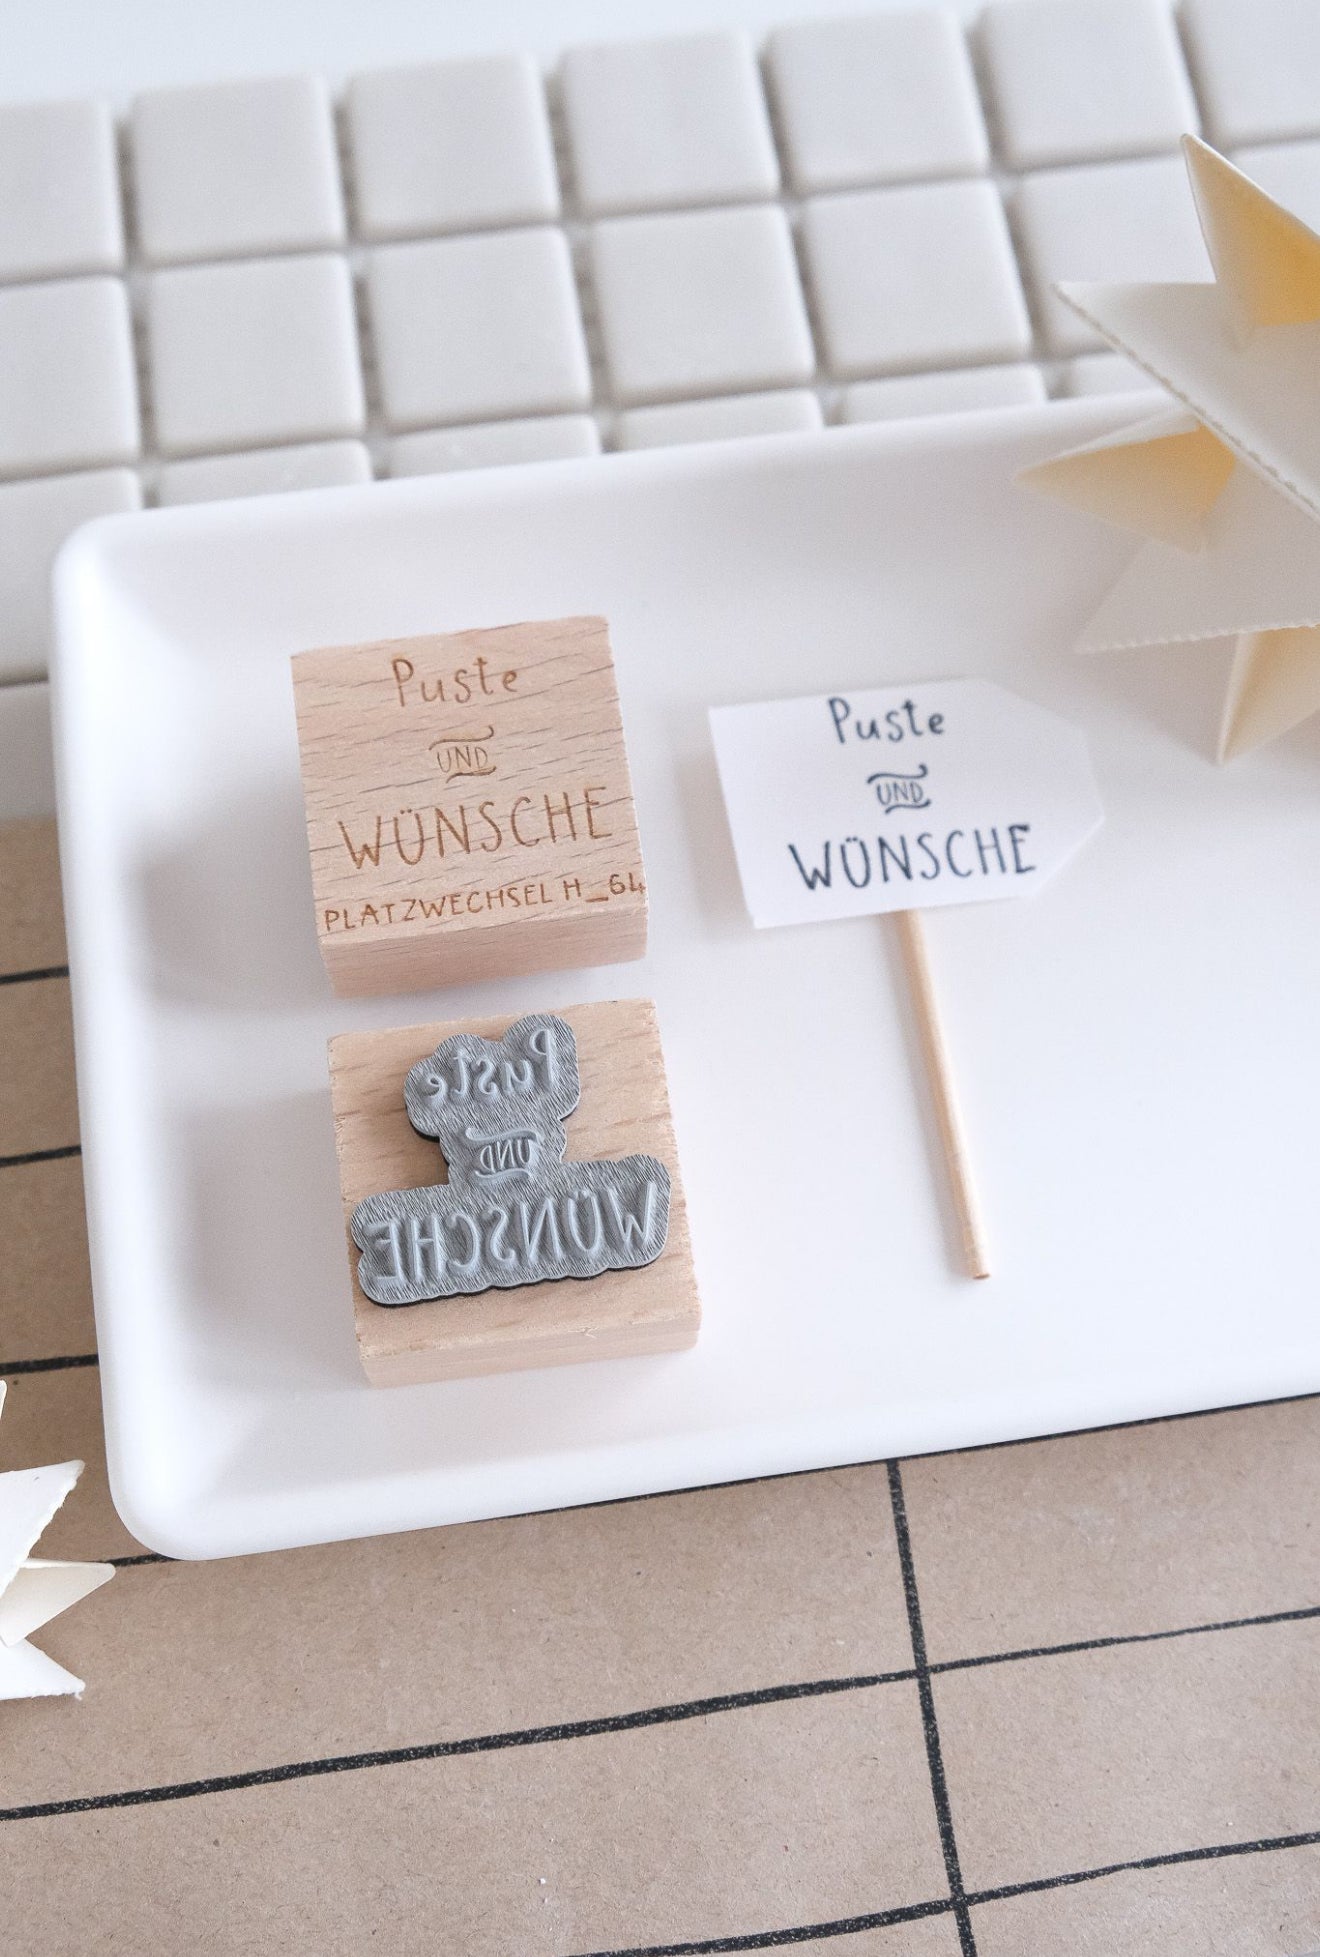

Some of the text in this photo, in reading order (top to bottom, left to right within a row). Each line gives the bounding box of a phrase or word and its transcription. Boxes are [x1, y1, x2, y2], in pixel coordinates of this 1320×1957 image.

[391, 656, 519, 708] Puste
[827, 696, 946, 744] Puste
[435, 745, 489, 773] UND
[875, 780, 925, 806] UND
[337, 786, 613, 870] WÜNSCHE
[786, 823, 1037, 891] WÜNSCHE
[324, 882, 554, 932] PLATZWECHSEL
